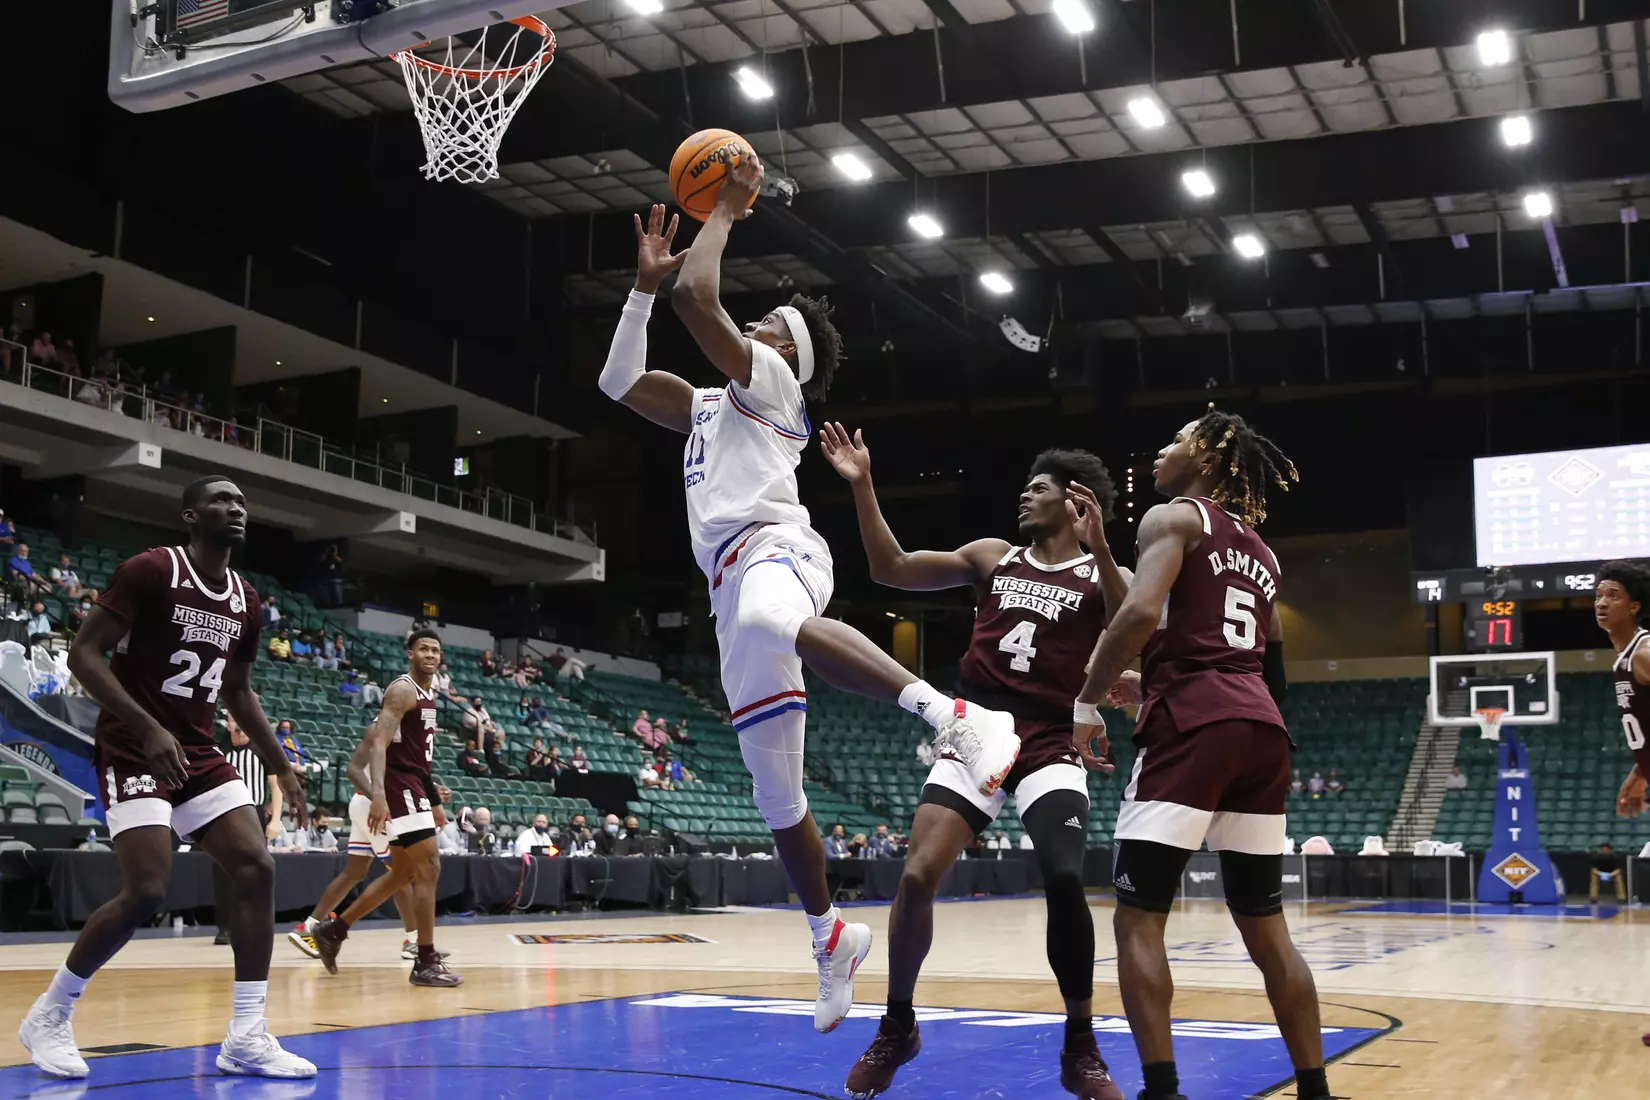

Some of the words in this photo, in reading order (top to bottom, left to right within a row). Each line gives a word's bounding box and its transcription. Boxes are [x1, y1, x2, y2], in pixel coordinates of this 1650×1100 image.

[1208, 548, 1276, 602] D.SMITH
[992, 578, 1083, 608] MISSISSIPPI
[1008, 596, 1051, 615] STATE
[1428, 587, 1442, 601] 14
[172, 607, 242, 637] MISSISSIPPI
[1223, 586, 1257, 650] 5
[1482, 601, 1515, 616] 9:52
[191, 629, 224, 647] STATE
[998, 620, 1037, 673] 4
[1488, 619, 1513, 645] 17
[161, 649, 227, 704] 24
[1621, 714, 1645, 750] 0
